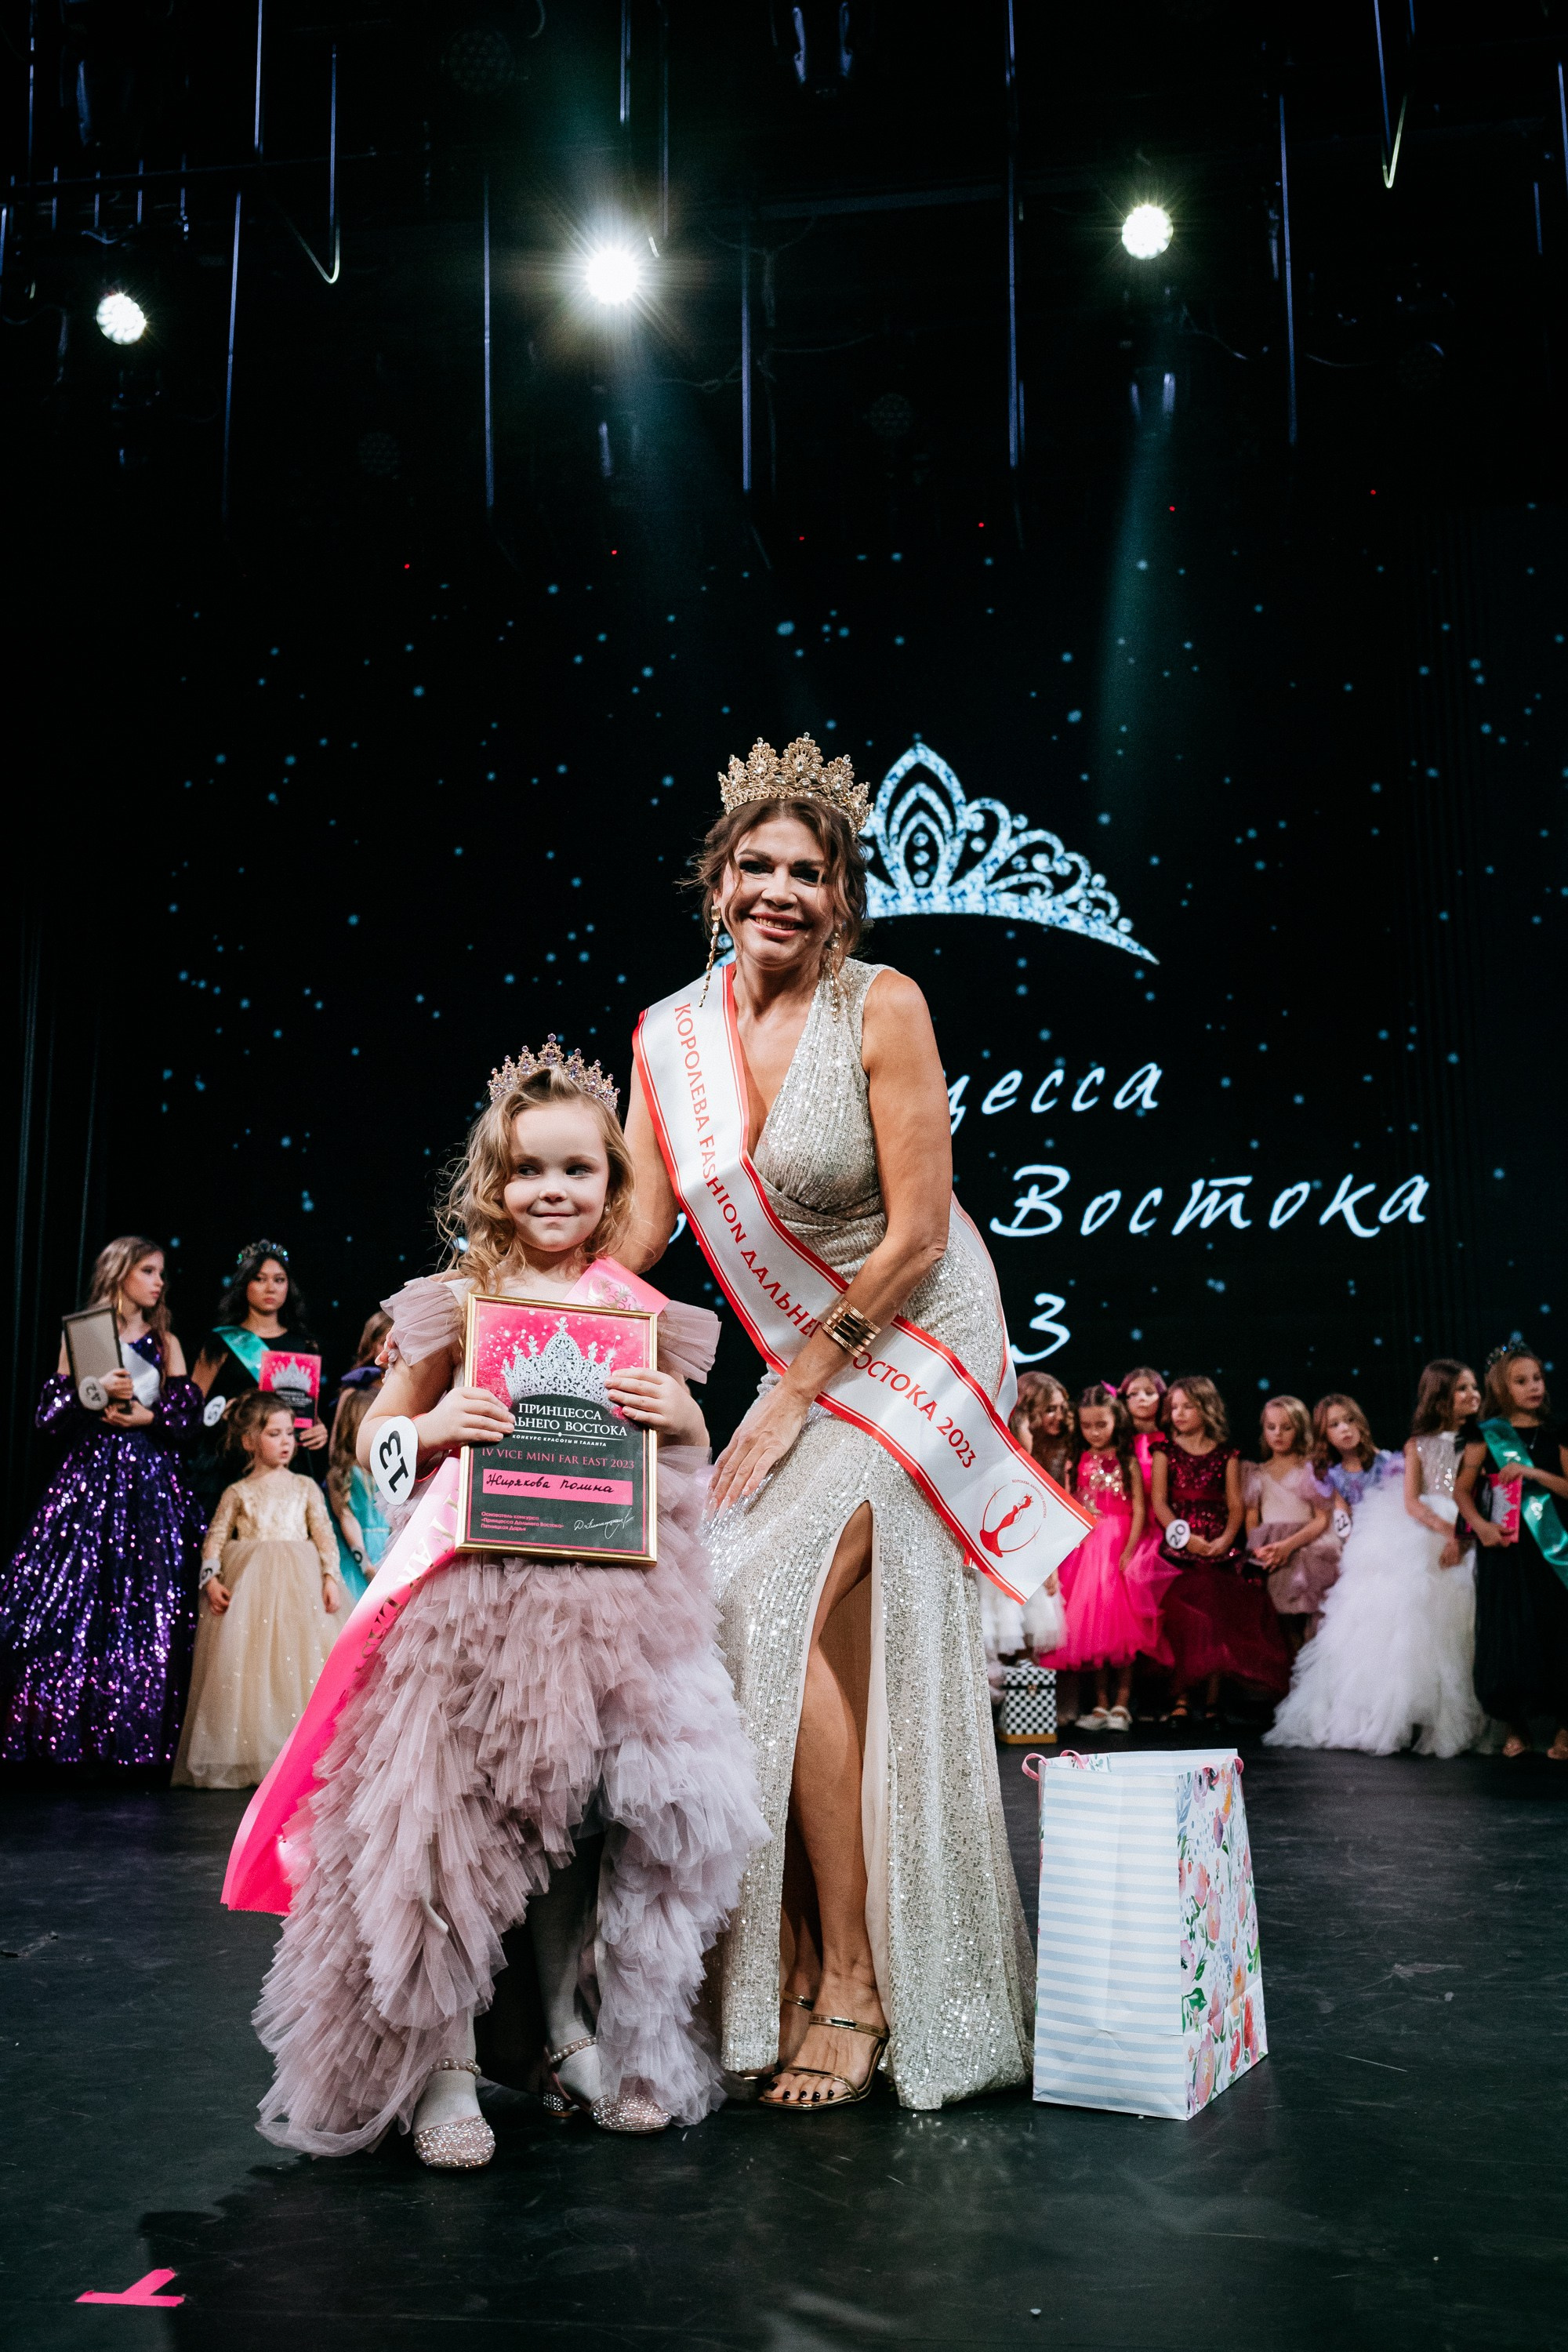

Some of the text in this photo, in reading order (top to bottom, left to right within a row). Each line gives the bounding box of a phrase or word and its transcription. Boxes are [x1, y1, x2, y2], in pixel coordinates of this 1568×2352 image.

[944, 1063, 1162, 1136] цесса
[989, 1165, 1429, 1237] Востока
[674, 1003, 976, 1468] КОРОЛЕВА FASHION ДАЛЬНЕГ ОСТОКА 2023
[85, 1383, 102, 1403] 42
[518, 1403, 602, 1421] ПРИНЦЕССА
[565, 1421, 628, 1436] ВОСТОКА
[379, 1430, 409, 1493] 13
[482, 1447, 635, 1469] IV VICE MINI FAR EAST 2023
[1169, 1523, 1187, 1547] 20
